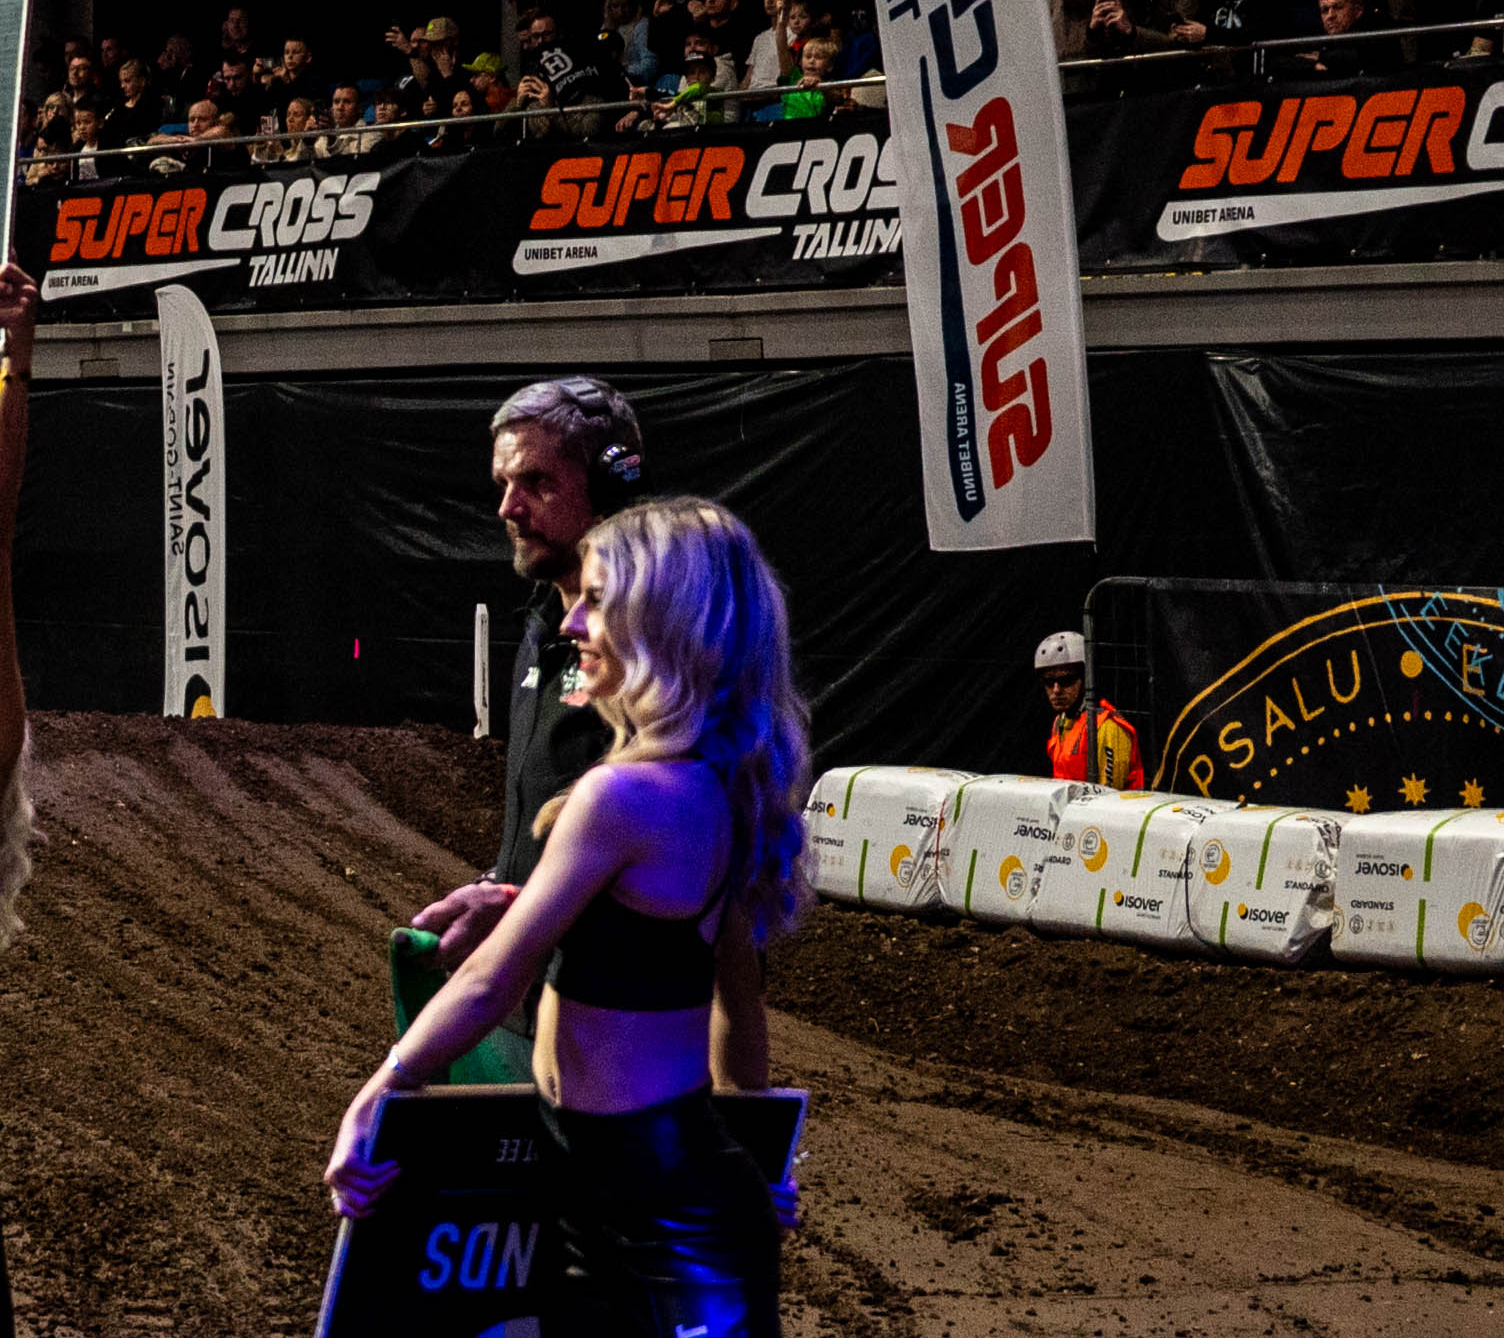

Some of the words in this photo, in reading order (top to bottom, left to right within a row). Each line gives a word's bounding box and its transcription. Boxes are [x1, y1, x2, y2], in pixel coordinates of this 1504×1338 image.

[1178, 85, 1466, 189] SUPER
[529, 146, 745, 230] SUPER
[745, 133, 900, 218] CROS
[50, 187, 207, 262] SUPER
[208, 171, 381, 252] CROSS
[1172, 208, 1217, 225] UNIBET
[1219, 206, 1255, 222] ARENA
[524, 247, 564, 260] UNIBET
[565, 245, 598, 259] ARENA
[792, 218, 903, 260] TALLIN
[249, 248, 339, 288] TALLINN
